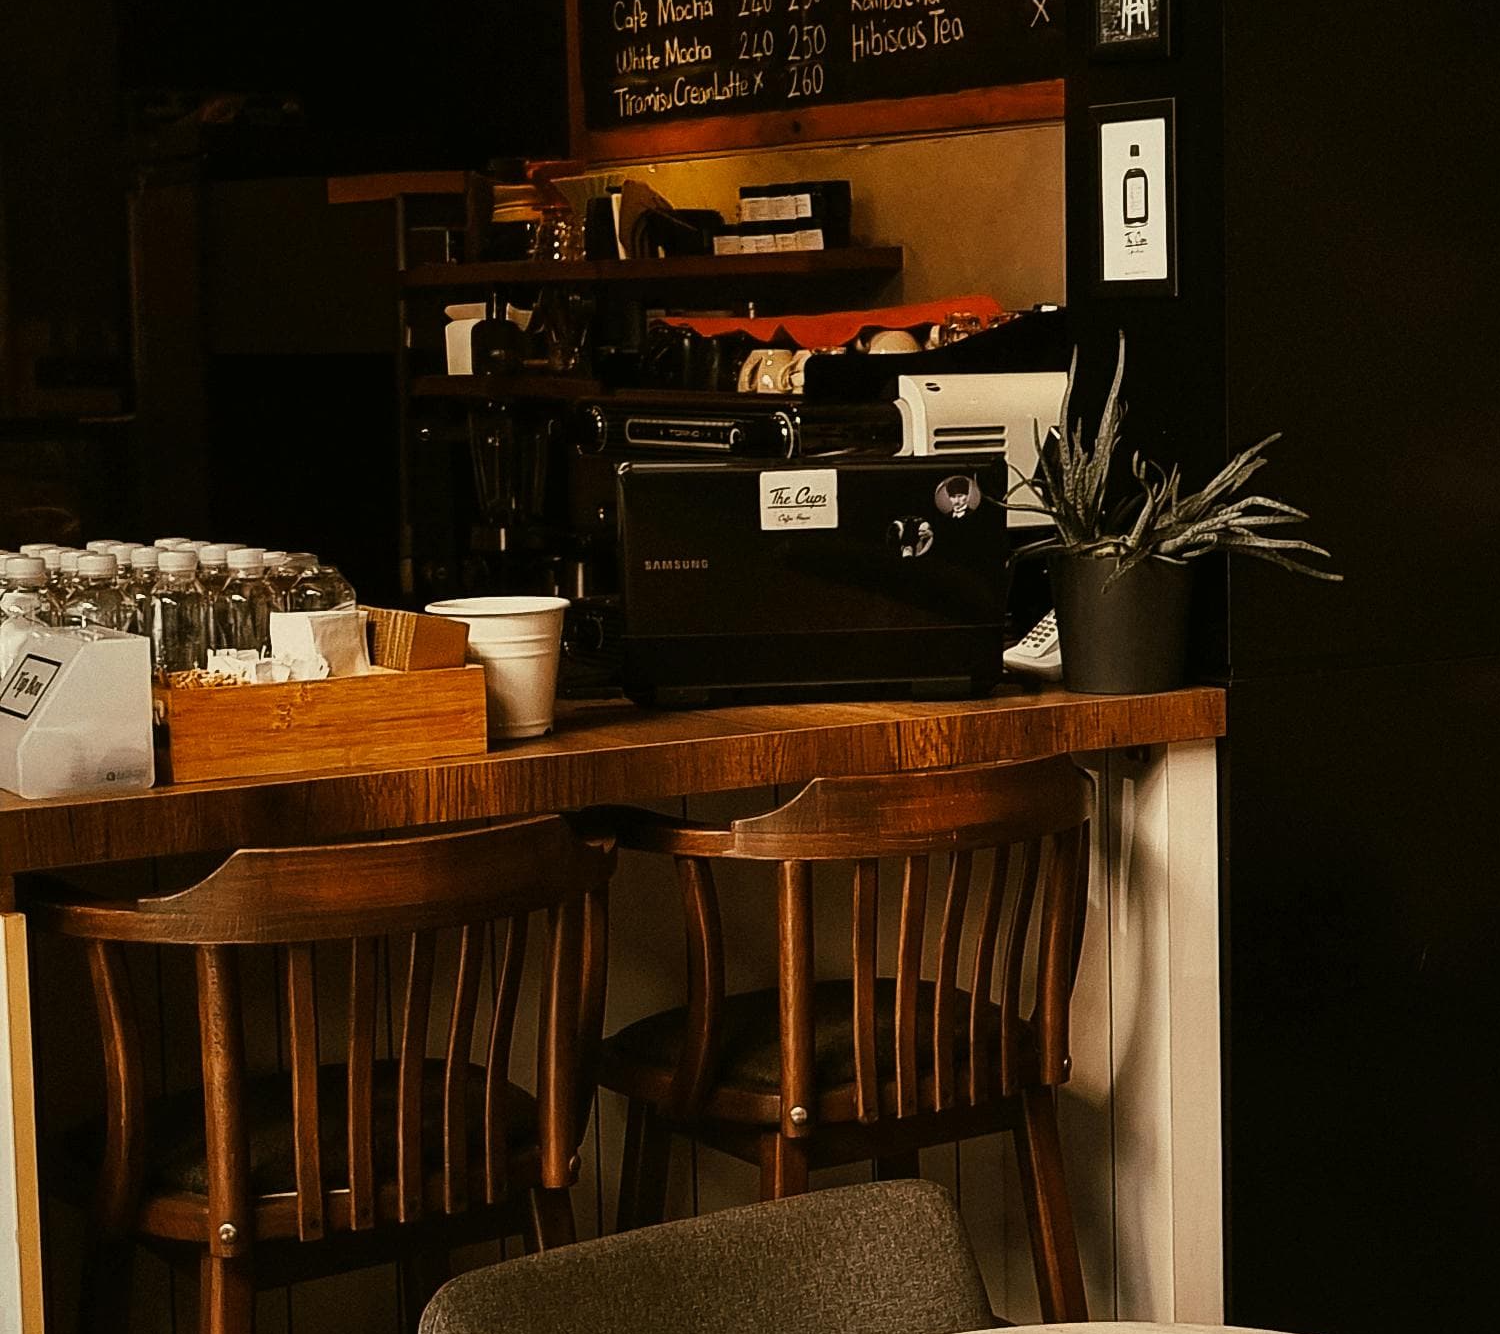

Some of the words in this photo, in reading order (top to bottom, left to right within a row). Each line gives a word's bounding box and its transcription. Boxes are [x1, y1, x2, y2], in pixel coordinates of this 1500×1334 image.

[616, 44, 660, 74] White
[665, 36, 712, 67] Mocha
[738, 29, 774, 61] 240
[787, 24, 826, 61] 250
[851, 19, 928, 63] Hibiscus
[928, 8, 965, 45] Tea
[787, 64, 824, 98] 260
[769, 486, 792, 505] The
[795, 486, 828, 508] Cups
[644, 558, 709, 570] SAMSUNG
